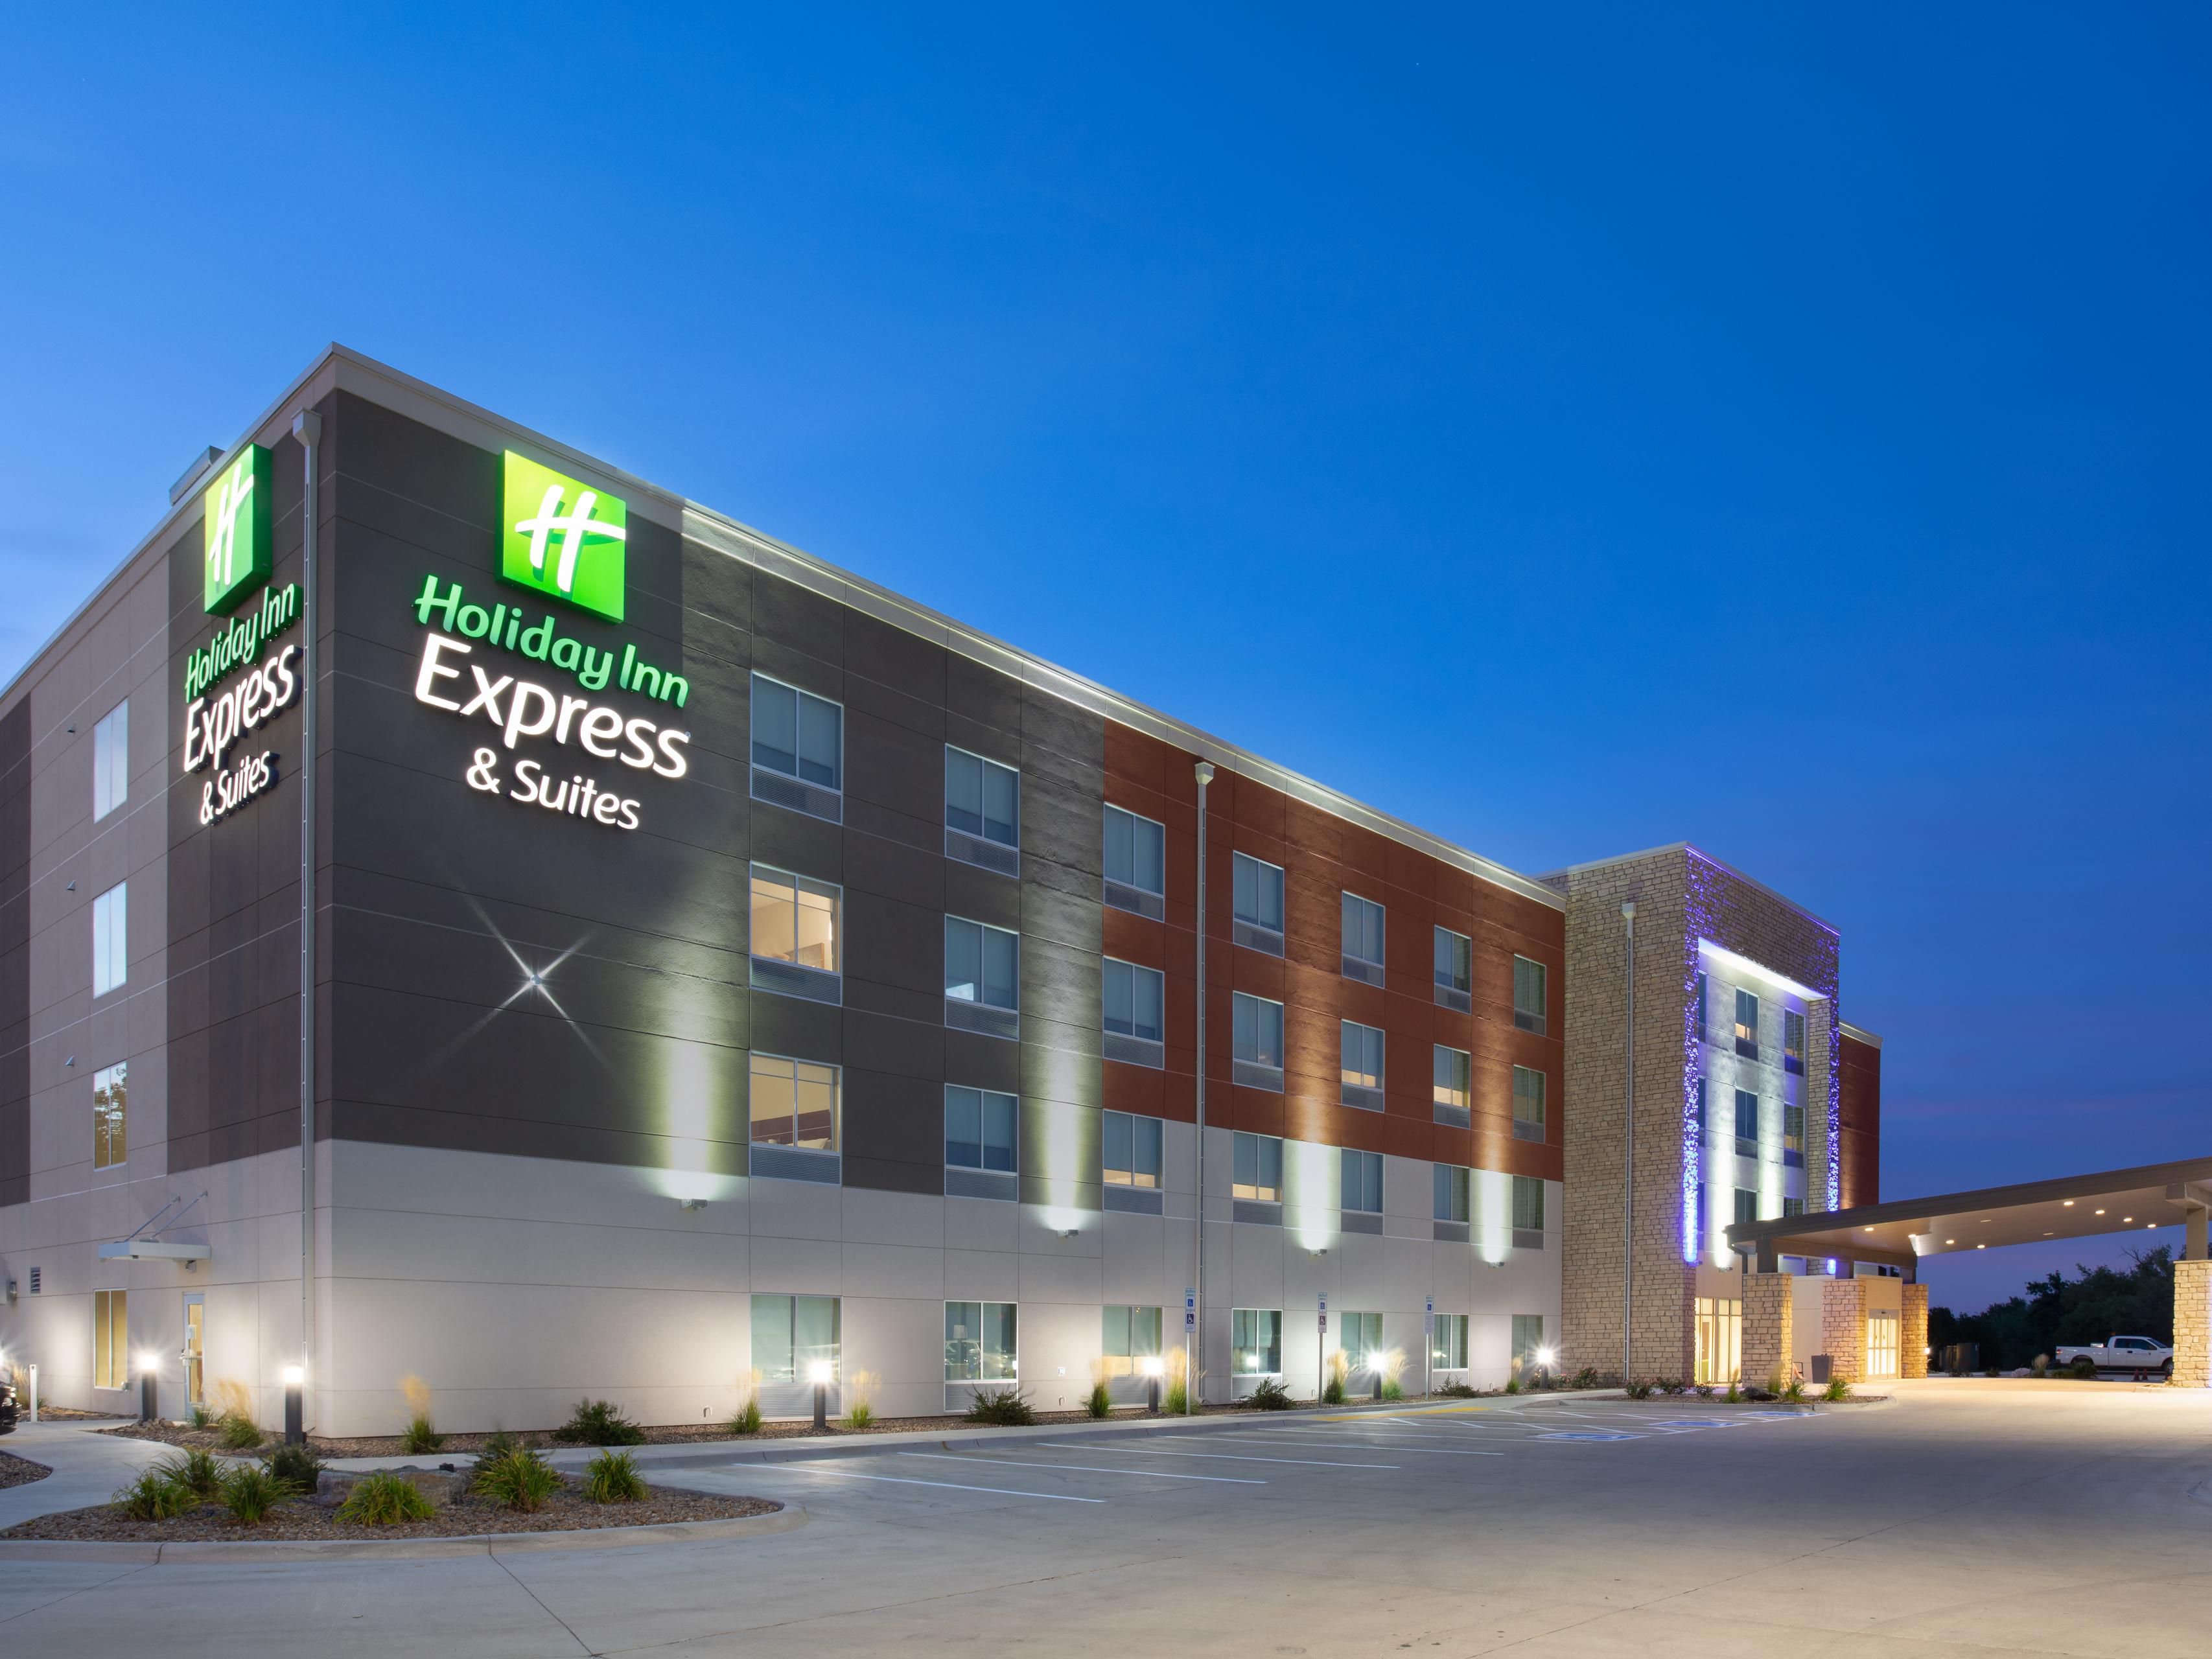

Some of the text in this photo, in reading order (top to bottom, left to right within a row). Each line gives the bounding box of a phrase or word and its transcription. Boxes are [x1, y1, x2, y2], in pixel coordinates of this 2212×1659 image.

[185, 583, 296, 703] Holiday Inn
[414, 575, 689, 708] Holiday Inn
[183, 644, 295, 772] Express
[415, 632, 690, 778] Express
[200, 750, 271, 825] & Suites
[466, 747, 640, 830] & Suites
